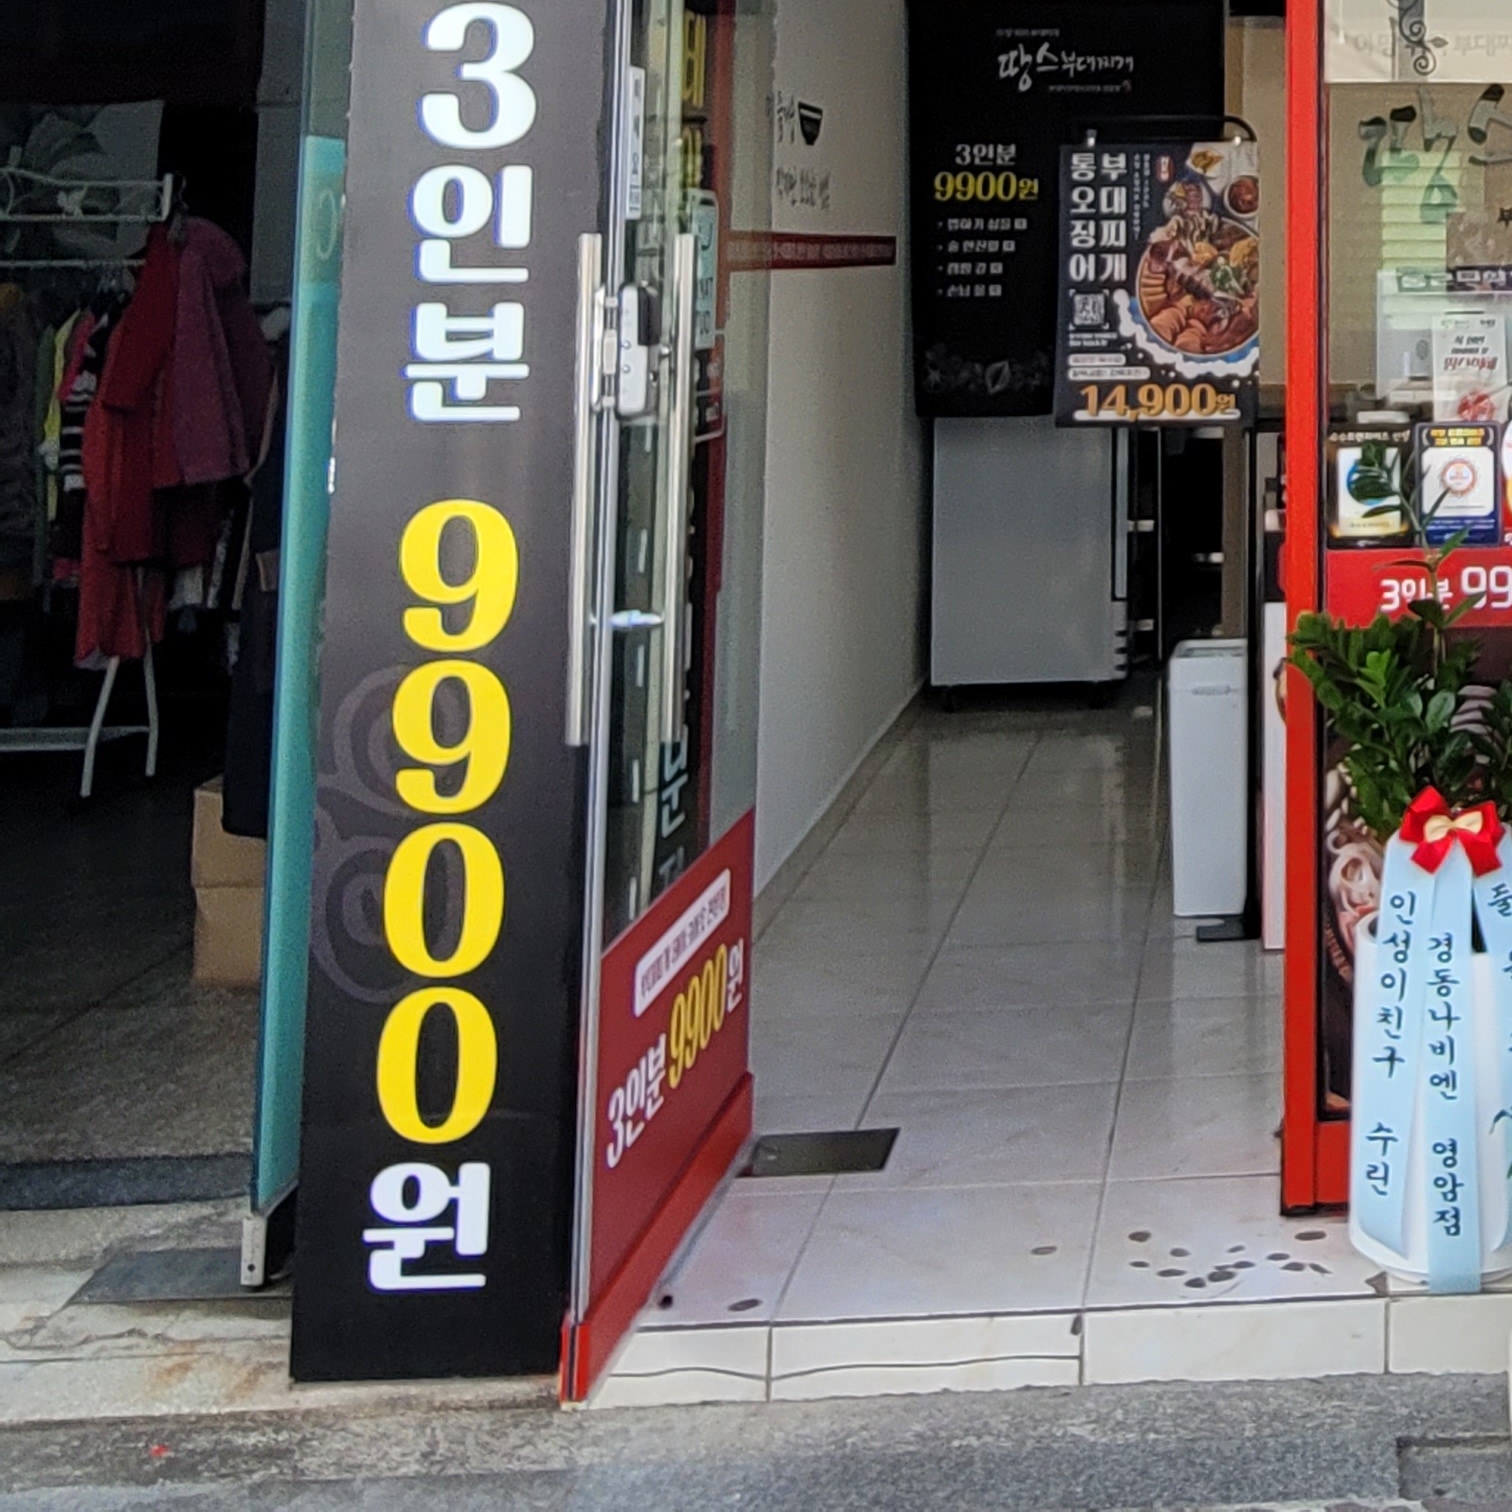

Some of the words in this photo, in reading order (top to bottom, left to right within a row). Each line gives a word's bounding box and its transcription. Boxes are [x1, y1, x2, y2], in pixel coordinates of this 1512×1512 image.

[403, 1, 538, 423] 3인분
[933, 170, 1040, 202] 9900원
[954, 143, 1017, 166] 3인분
[1069, 152, 1097, 283] 통오징어
[1099, 152, 1128, 283] 부대찌개
[1080, 382, 1236, 423] 14,900원
[363, 499, 519, 1291] 9900원
[605, 1032, 667, 1169] 3인분
[667, 937, 745, 1089] 9900원
[1431, 1137, 1464, 1238] 영암점
